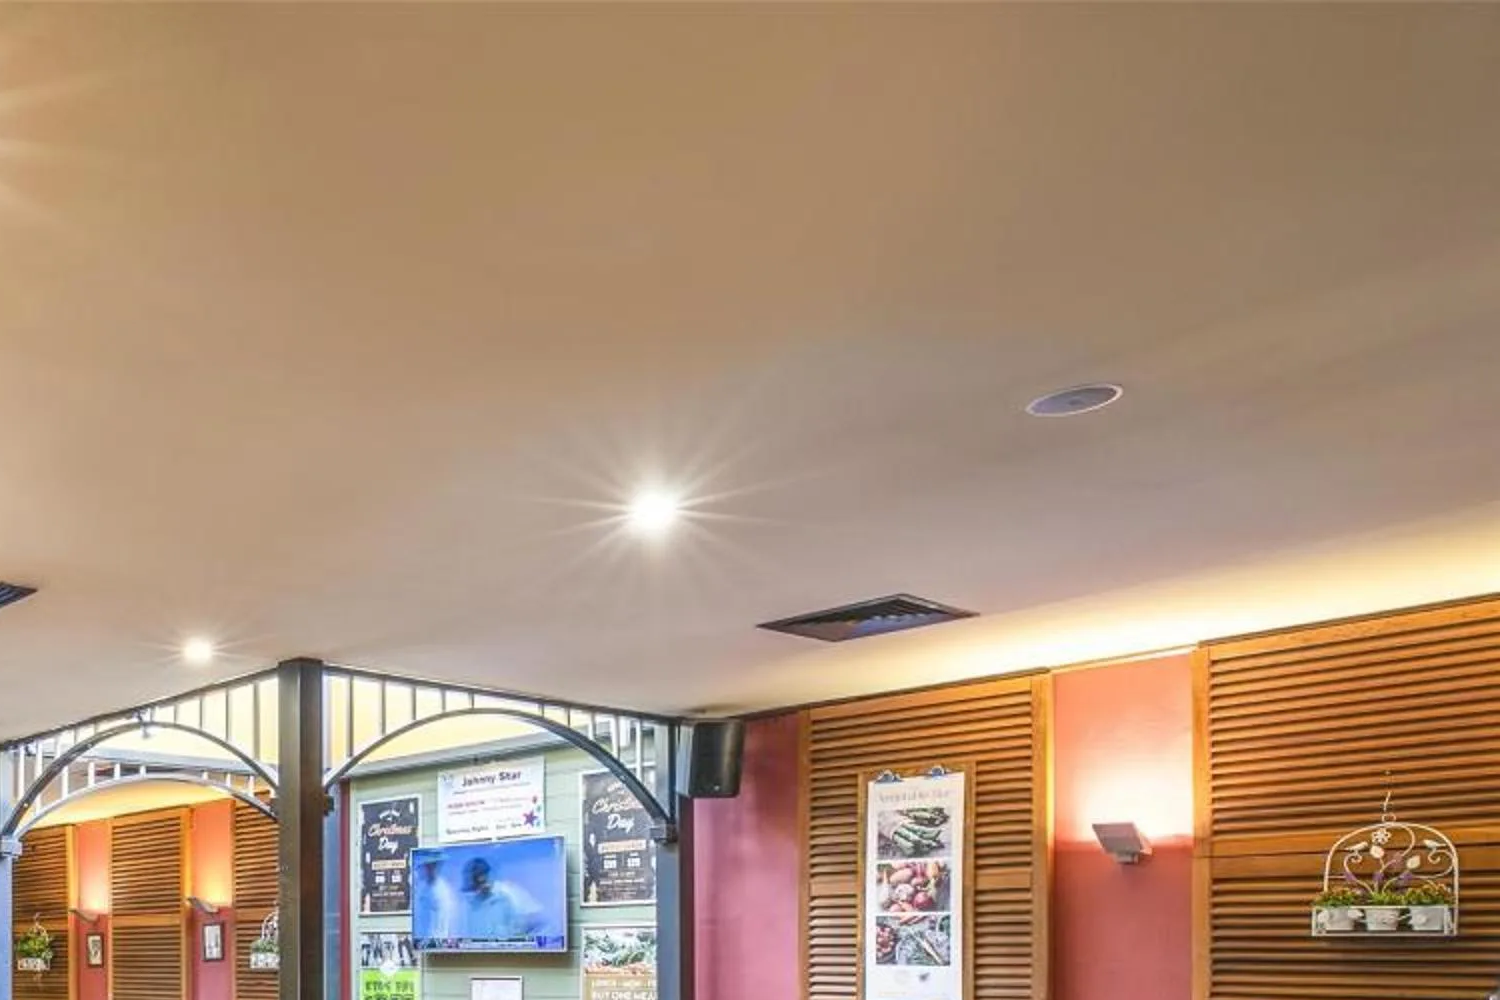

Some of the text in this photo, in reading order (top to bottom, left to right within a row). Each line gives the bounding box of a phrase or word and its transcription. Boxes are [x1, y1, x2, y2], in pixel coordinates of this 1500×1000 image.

[461, 776, 496, 788] Johnny
[498, 770, 521, 782] Star
[606, 812, 635, 834] Day
[378, 835, 399, 855] Day
